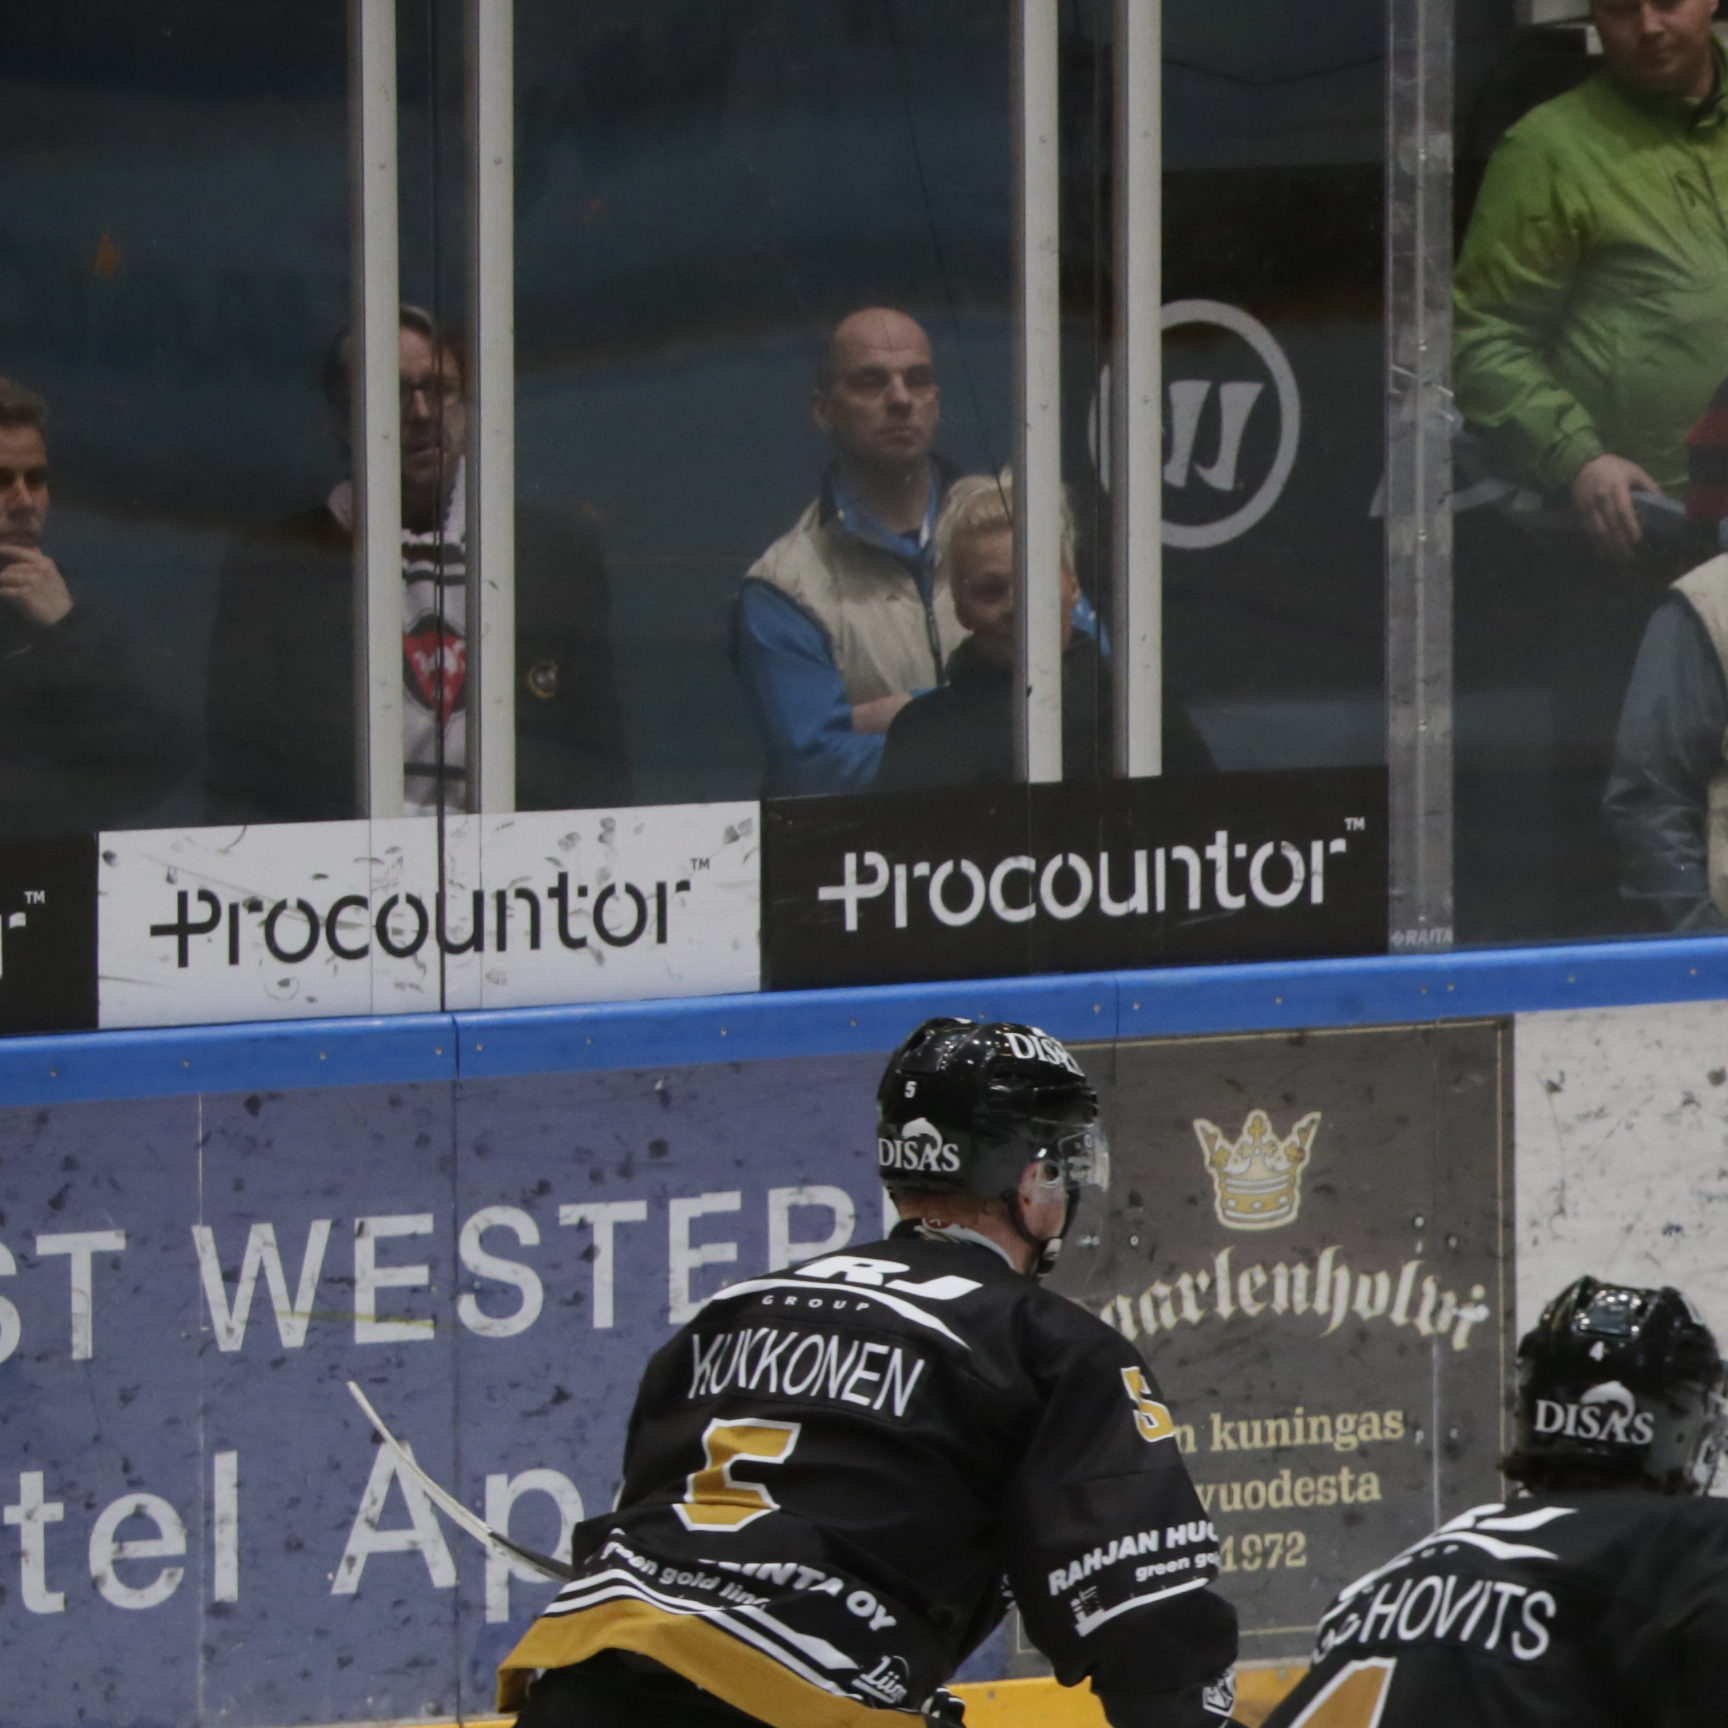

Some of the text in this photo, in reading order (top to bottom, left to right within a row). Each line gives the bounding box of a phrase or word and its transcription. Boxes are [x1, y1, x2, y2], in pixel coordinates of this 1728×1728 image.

[819, 830, 1347, 932] Procountor
[150, 871, 692, 969] Procountor
[904, 1080, 918, 1099] 5
[877, 1137, 962, 1173] DISAS
[191, 1181, 898, 1354] WESTER
[762, 1295, 870, 1313] GROUP
[687, 1326, 926, 1418] KUKKONEN
[1121, 1366, 1176, 1443] 5
[1534, 1398, 1656, 1446] DISAS
[1210, 1407, 1406, 1453] kuningas
[1196, 1466, 1382, 1513] vuodesta
[1048, 1529, 1160, 1597] RAHJAN
[1134, 1554, 1190, 1583] green
[1219, 1531, 1307, 1573] 1972
[659, 1565, 721, 1591] gold
